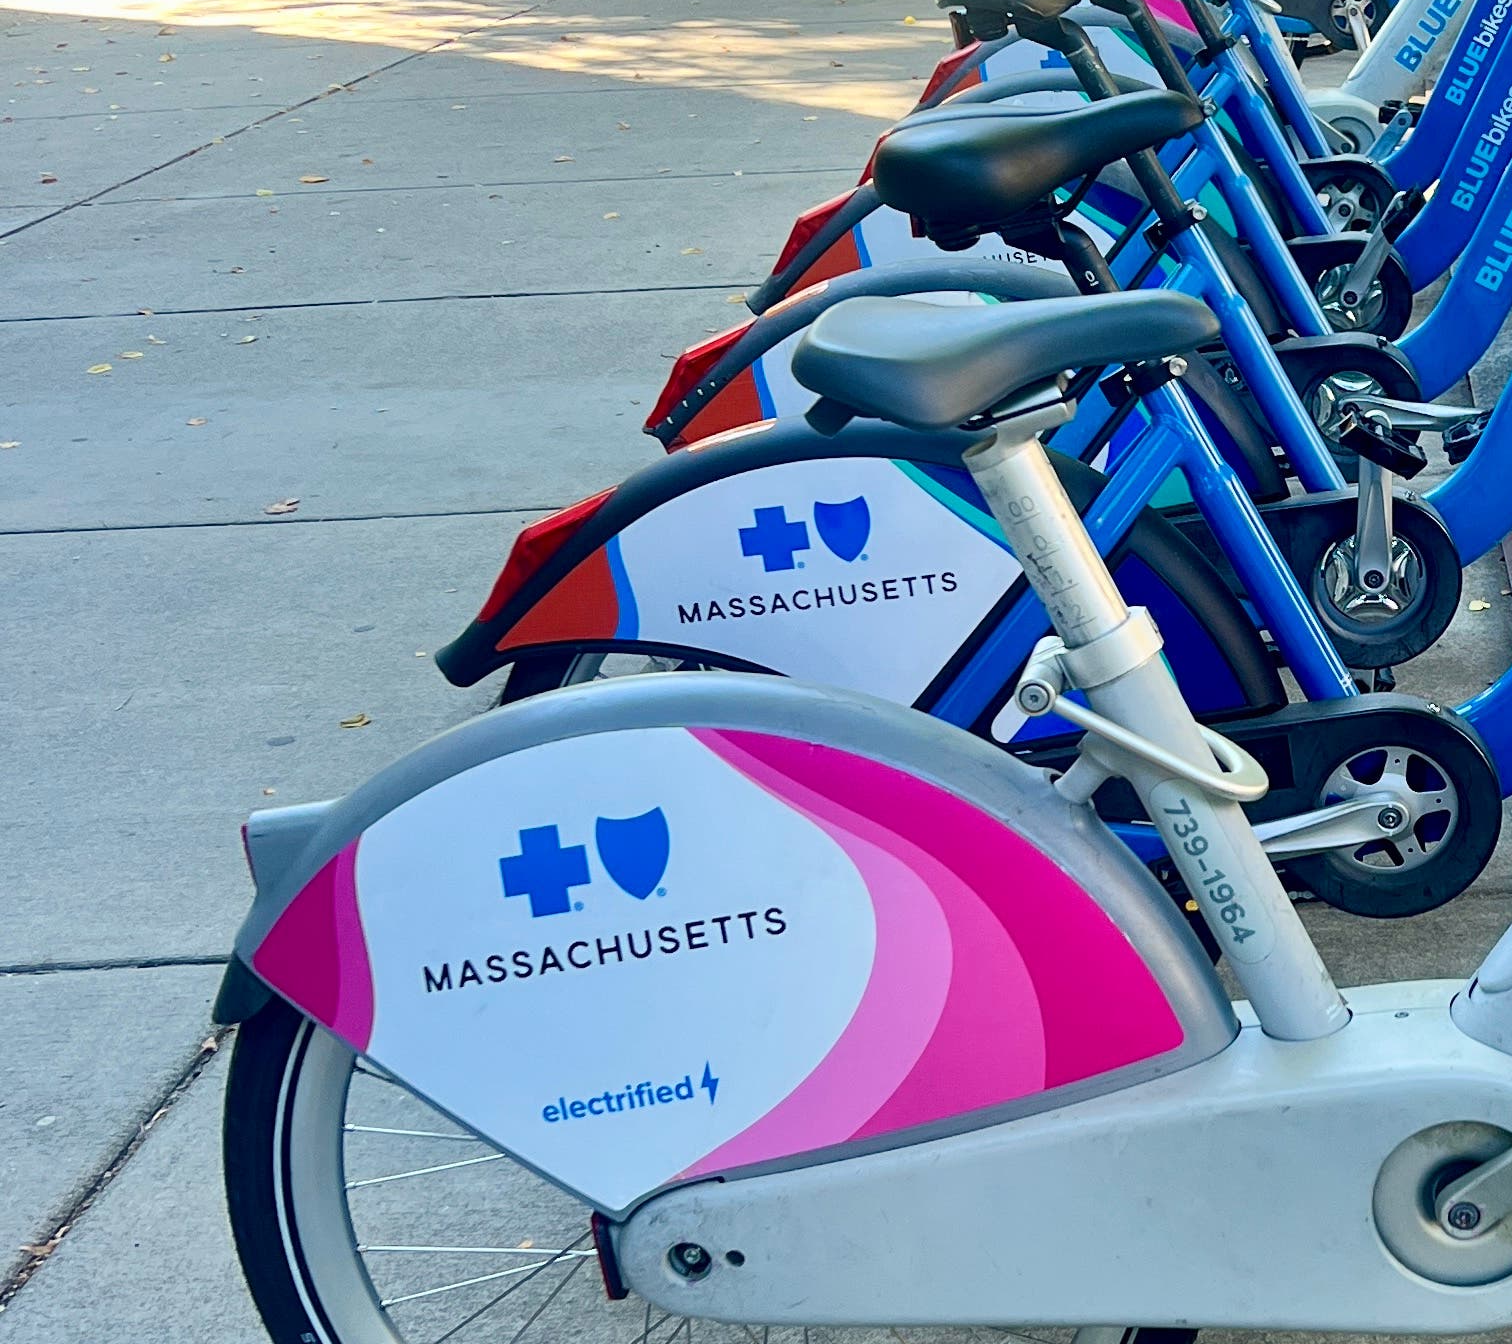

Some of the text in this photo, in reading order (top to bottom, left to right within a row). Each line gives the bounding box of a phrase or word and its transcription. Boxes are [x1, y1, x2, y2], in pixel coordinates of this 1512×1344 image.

[679, 571, 958, 624] MASSACHUSETTS
[1164, 798, 1256, 946] 739-1964
[424, 908, 788, 994] MASSACHUSETTS
[542, 1074, 695, 1124] electrified
